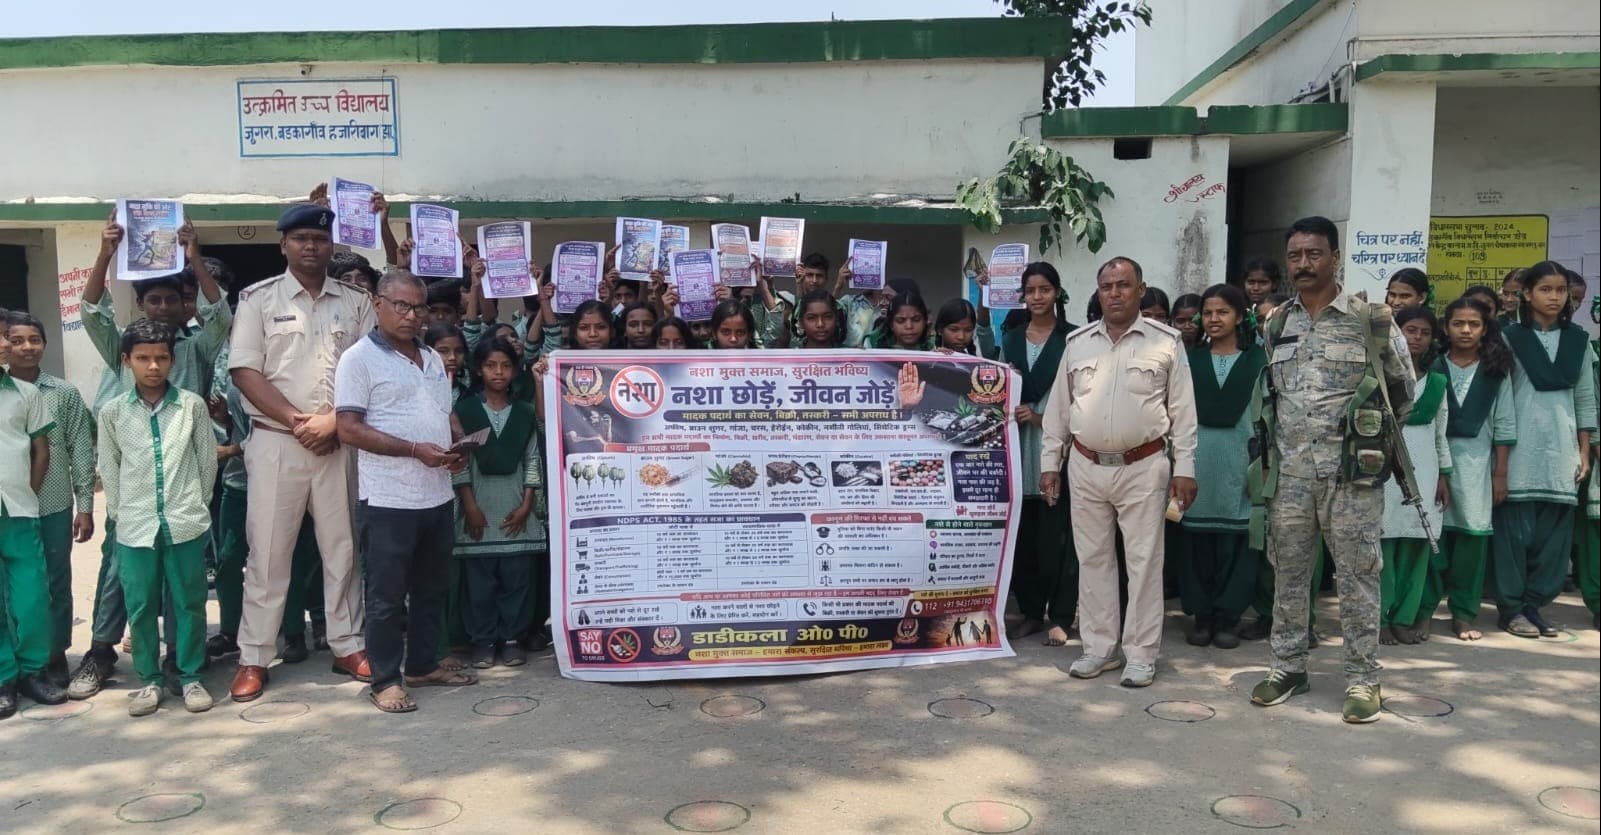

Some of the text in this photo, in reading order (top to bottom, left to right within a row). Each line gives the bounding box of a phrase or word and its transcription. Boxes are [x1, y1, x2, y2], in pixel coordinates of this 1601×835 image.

[242, 89, 296, 116] उत्क्रमित
[336, 89, 390, 113] विद्यालय
[60, 268, 80, 283] अपनी
[689, 364, 870, 380] नशा मुक्त समाज, सुरक्षित भविष्य
[618, 382, 657, 402] नशा
[671, 380, 896, 409] नशा छोड़ें, जीवन जोड़ें
[580, 632, 599, 641] SAY
[691, 627, 788, 644] डाडीकला
[580, 642, 601, 654] NO
